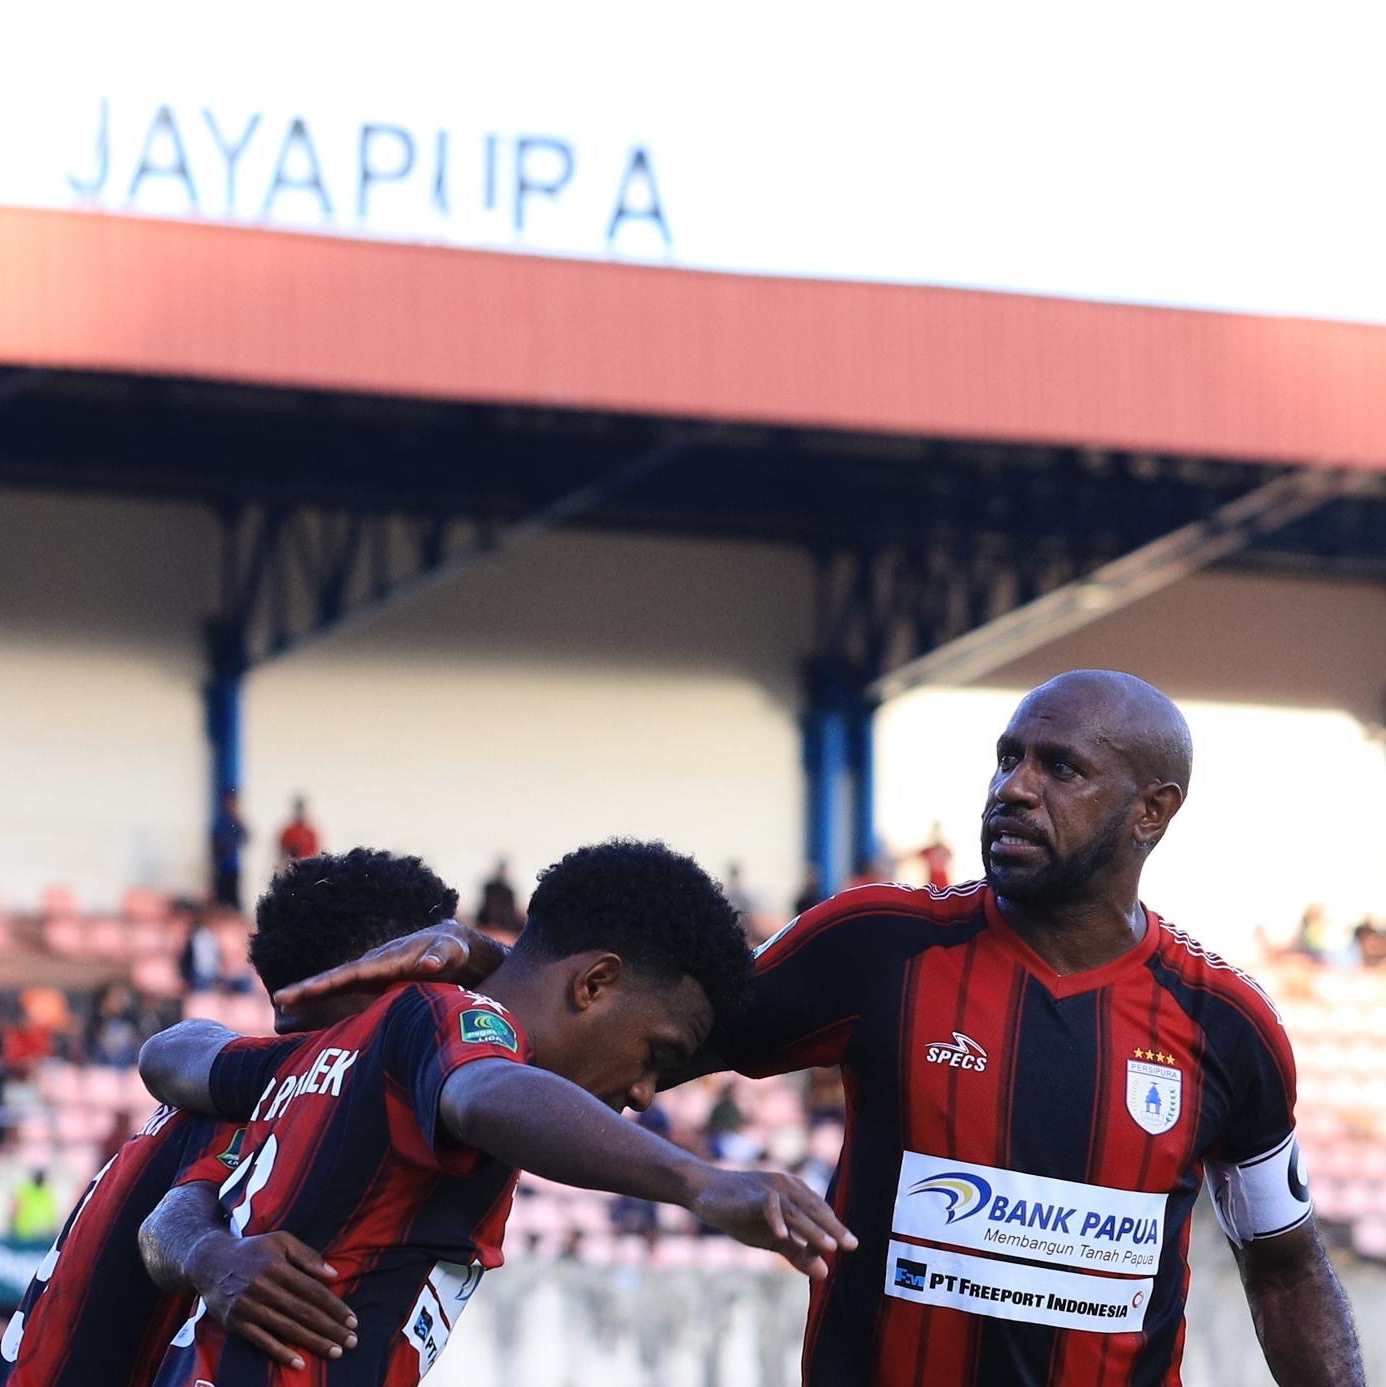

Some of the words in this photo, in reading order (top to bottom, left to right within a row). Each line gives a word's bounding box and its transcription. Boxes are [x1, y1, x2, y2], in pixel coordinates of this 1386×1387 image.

[65, 96, 675, 254] JAYAPURA
[926, 1047, 988, 1072] SPECS
[1130, 1063, 1178, 1078] PERSIPURA
[988, 1195, 1077, 1234] BANK
[1080, 1211, 1158, 1245] PAPUA
[984, 1228, 1075, 1256] Membangun
[1080, 1244, 1120, 1263] Tanah
[1122, 1250, 1155, 1268] Papua
[929, 1272, 958, 1292] PT
[959, 1278, 1045, 1309] FREEPORT
[1047, 1293, 1128, 1318] INDONESIA
